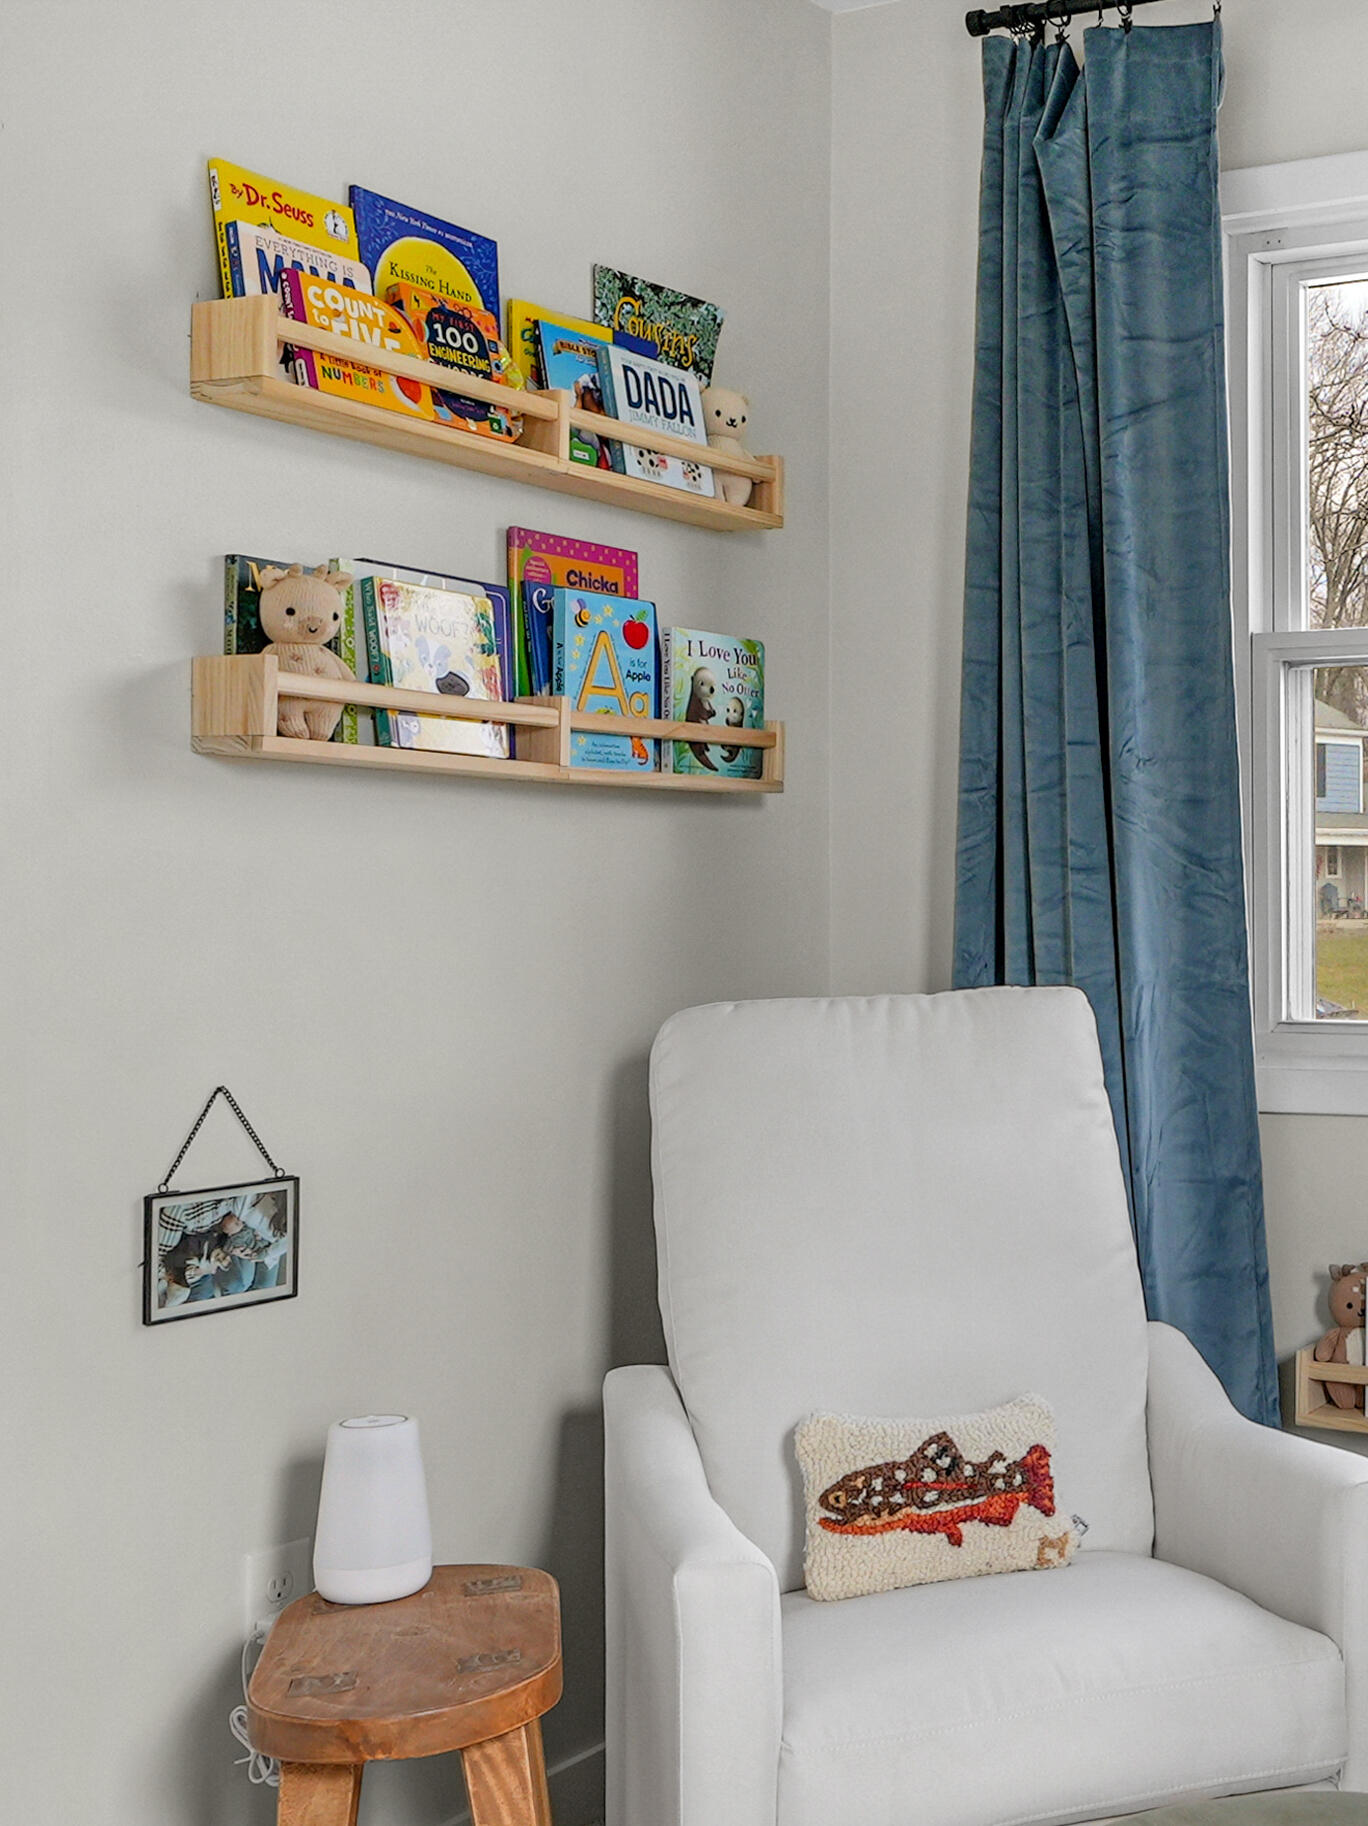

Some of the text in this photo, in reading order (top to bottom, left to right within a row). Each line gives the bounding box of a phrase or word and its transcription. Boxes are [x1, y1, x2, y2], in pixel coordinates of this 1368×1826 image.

[229, 183, 243, 199] By
[242, 182, 271, 209] Dr.
[271, 192, 314, 228] Seuss
[255, 235, 338, 272] EVERYTHING
[342, 264, 354, 278] IS
[425, 264, 437, 275] The
[389, 261, 472, 302] KISSING HAND
[307, 285, 386, 327] COUNT
[312, 308, 330, 326] to
[433, 322, 479, 354] 100
[613, 296, 698, 367] Cousins
[428, 342, 492, 373] ENGINEERING
[321, 365, 385, 393] NUMBERS
[622, 364, 695, 427] DADA
[661, 420, 697, 439] FALLON
[364, 581, 373, 605] Who
[566, 569, 619, 594] Chicka
[415, 612, 469, 639] WOOF?
[368, 630, 379, 662] WOOF?
[687, 639, 758, 666] I Love You
[625, 670, 652, 683] Apple
[629, 658, 647, 668] is for
[727, 667, 748, 680] Like
[721, 682, 760, 698] No Otter
